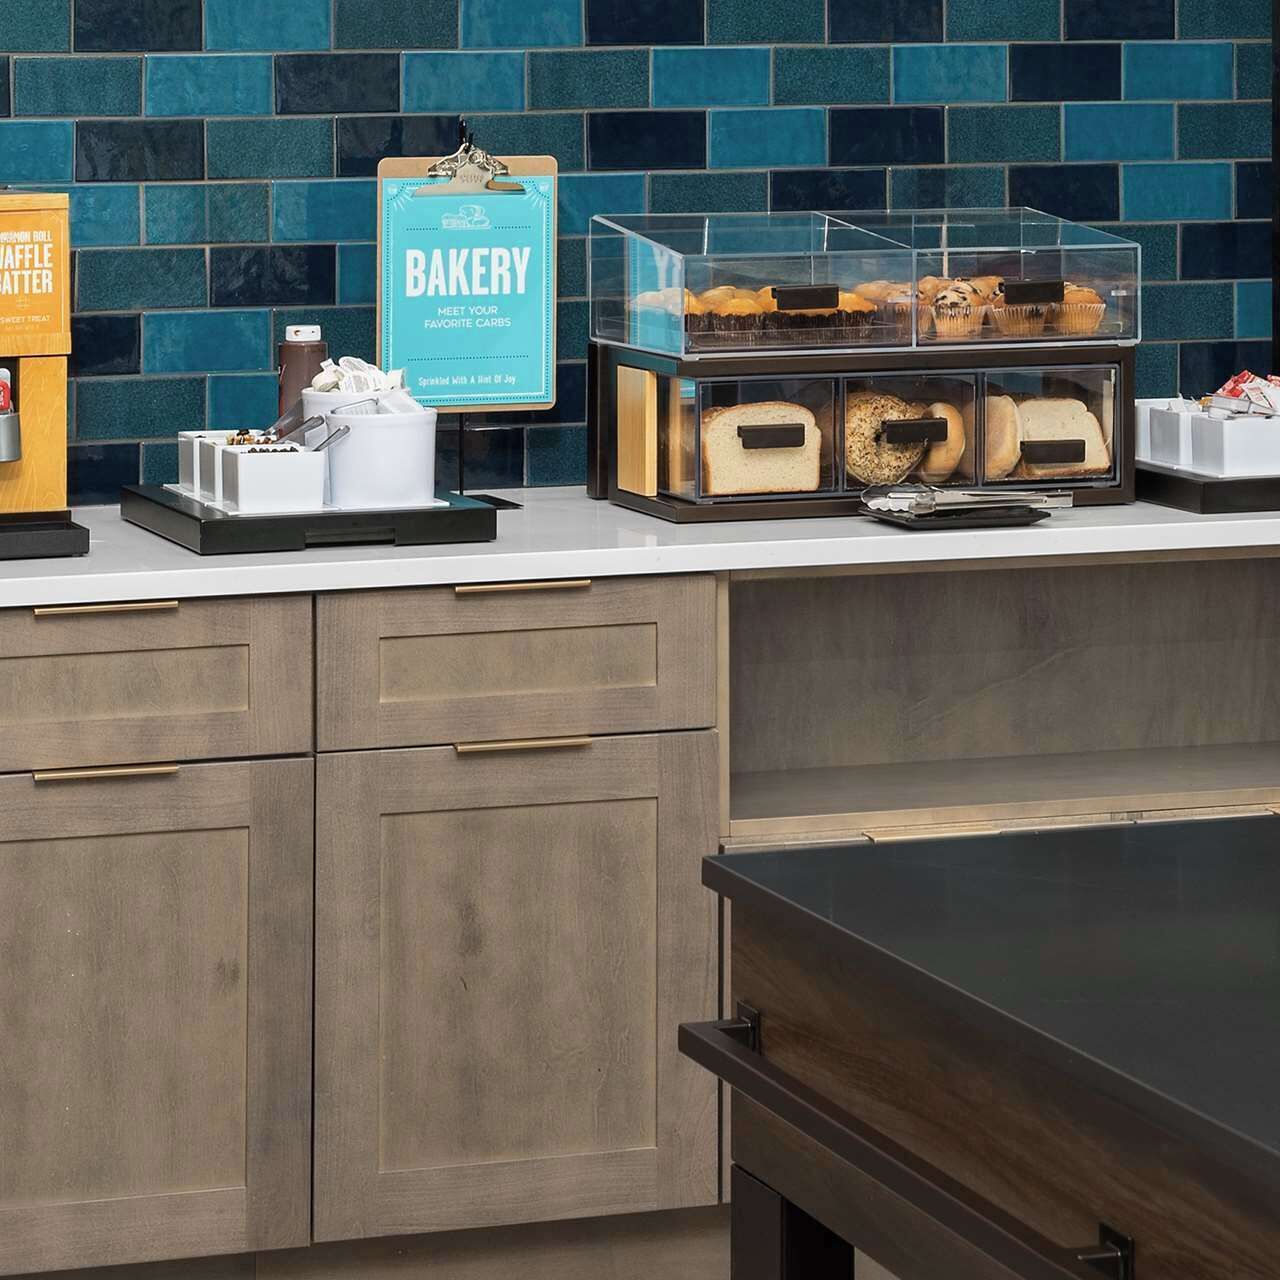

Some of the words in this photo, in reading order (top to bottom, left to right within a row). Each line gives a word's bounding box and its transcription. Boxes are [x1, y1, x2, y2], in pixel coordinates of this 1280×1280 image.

[405, 246, 531, 298] BAKERY
[438, 307, 465, 316] MEET
[468, 305, 498, 316] YOUR
[424, 318, 473, 329] FAVORITE
[476, 317, 512, 328] CARBS
[418, 376, 449, 388] Sprinkled
[451, 376, 467, 385] With
[470, 375, 475, 384] A
[494, 374, 502, 384] Of
[504, 374, 517, 385] Joy
